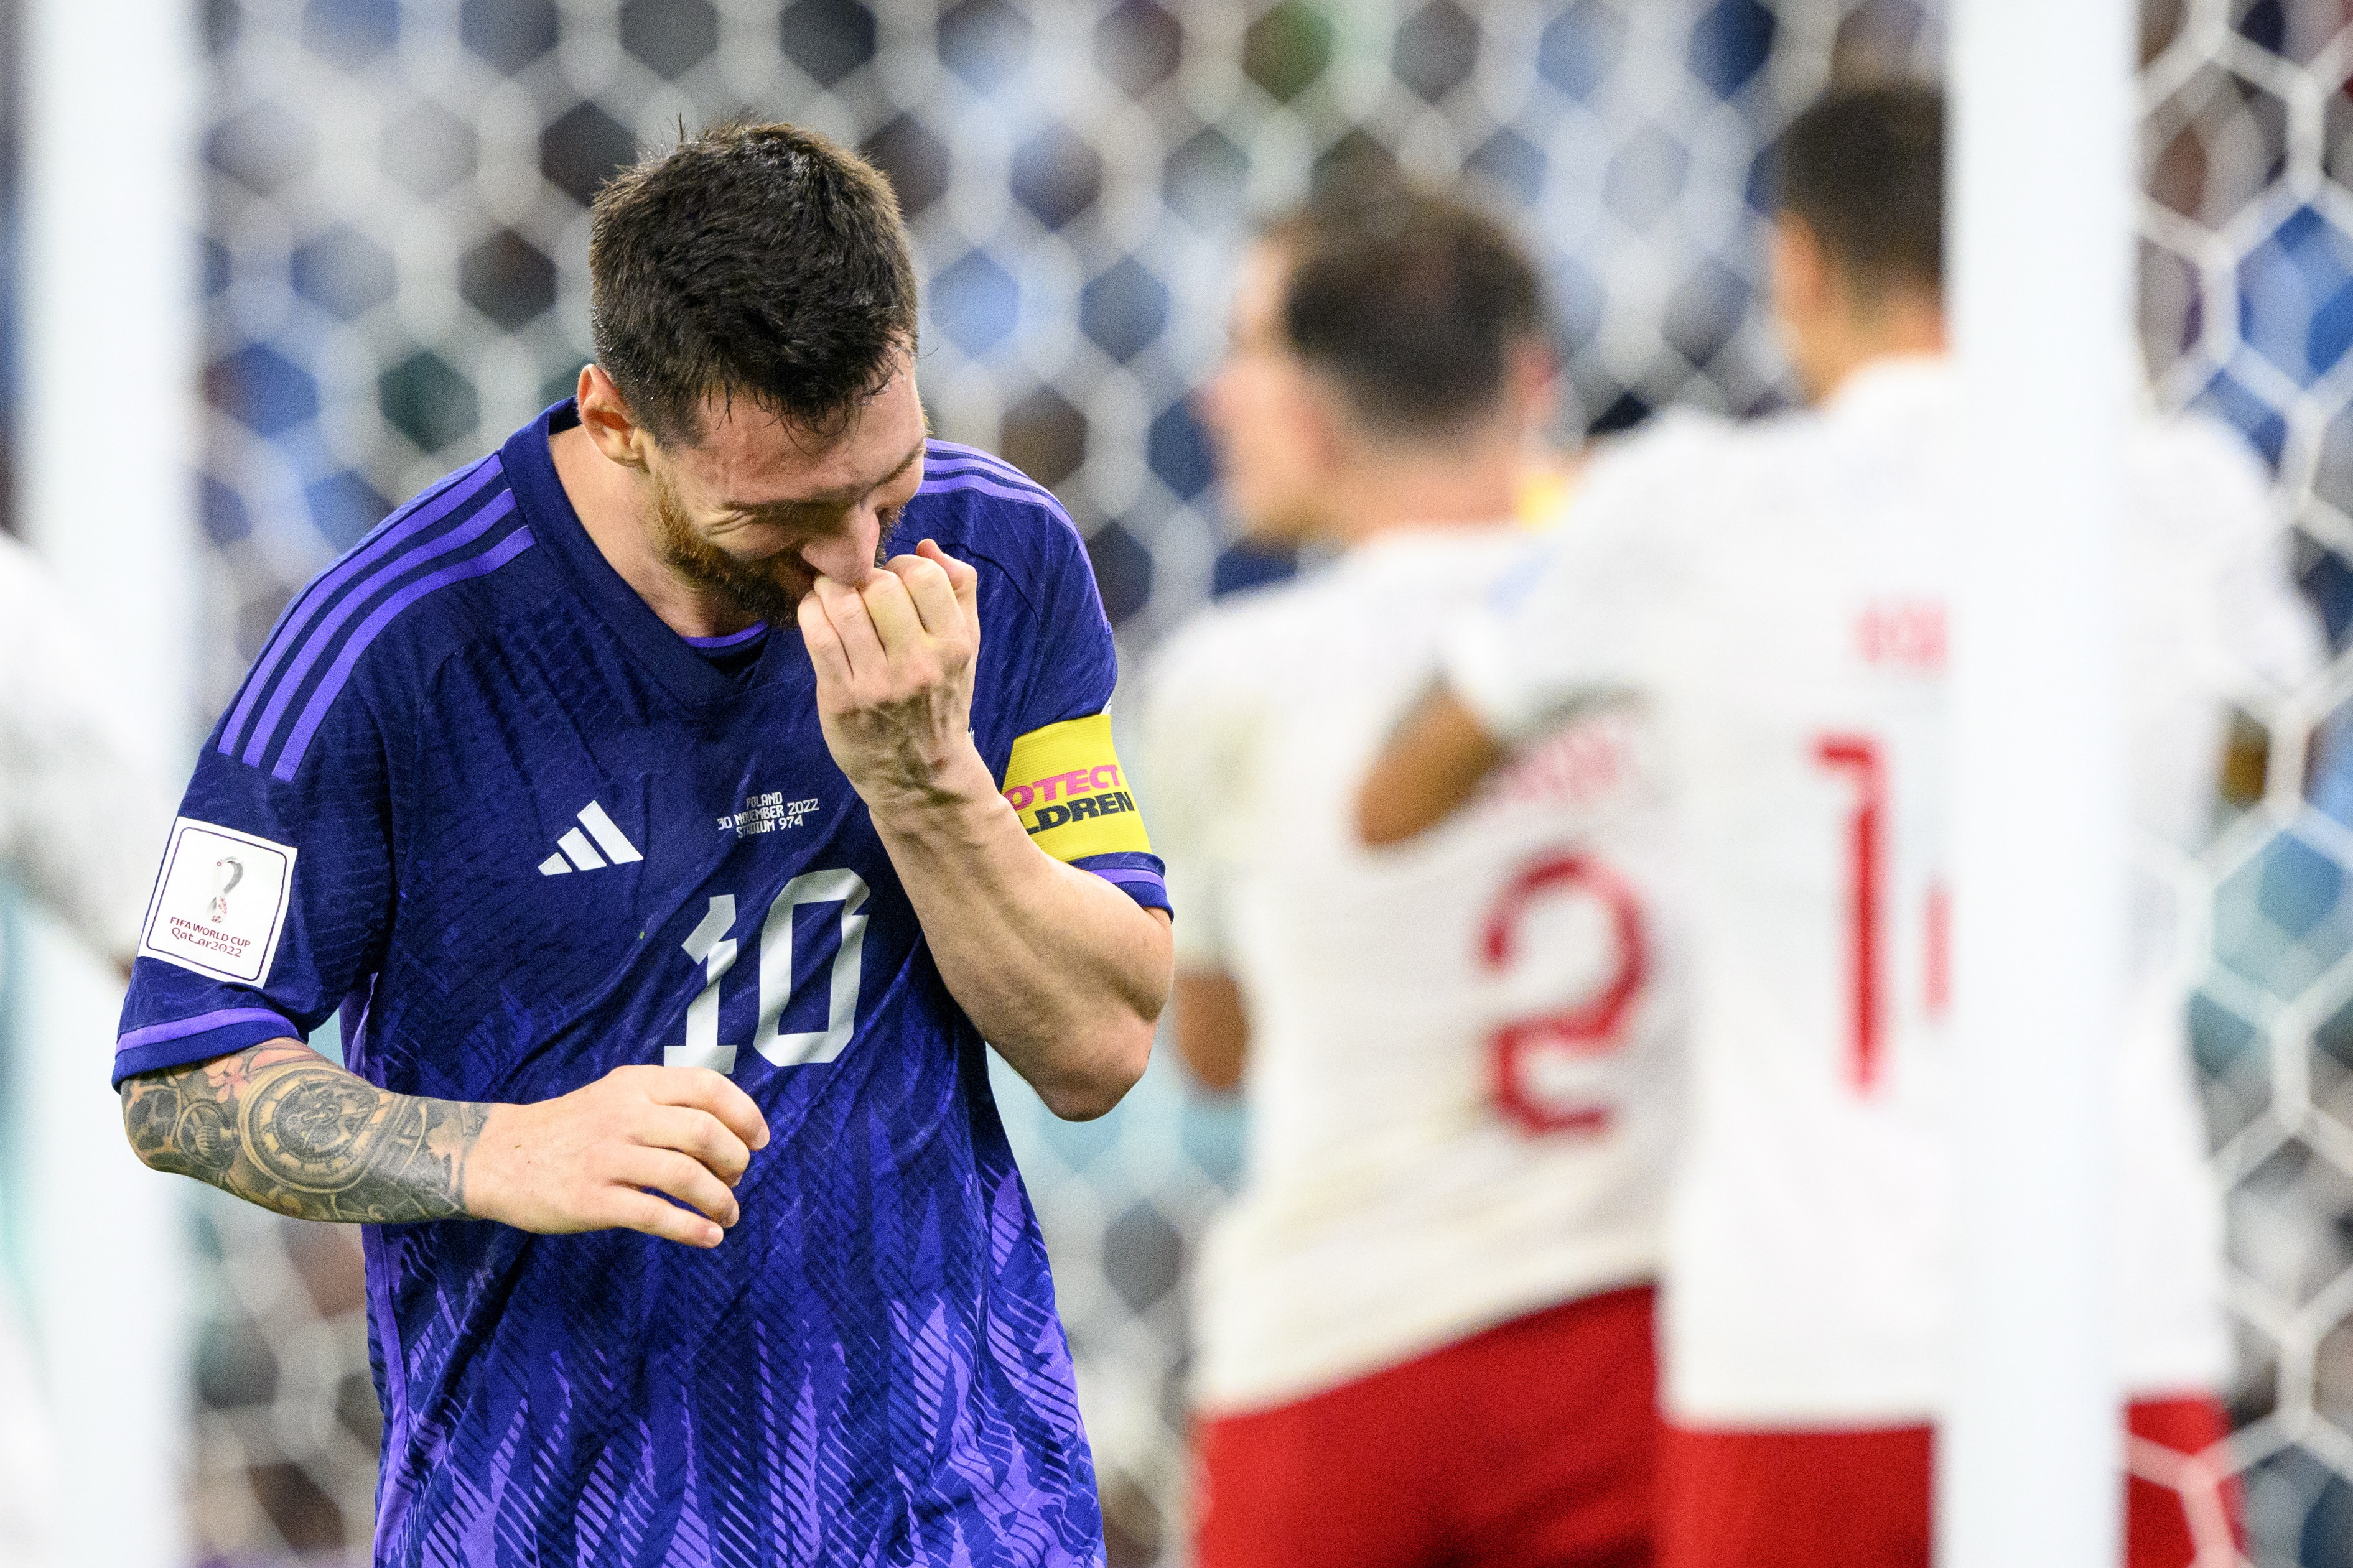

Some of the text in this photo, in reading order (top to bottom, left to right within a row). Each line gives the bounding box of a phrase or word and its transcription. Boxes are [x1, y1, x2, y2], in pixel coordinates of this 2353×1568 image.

[717, 798, 819, 830] 30 NOVEMBER 2022
[747, 792, 783, 809] POLAND
[737, 815, 804, 838] STADIUM 974
[1804, 731, 1950, 1098] 1
[170, 916, 251, 947] FIFA WORLD CUP
[663, 868, 870, 1074] 10
[1478, 849, 1649, 1138] 2
